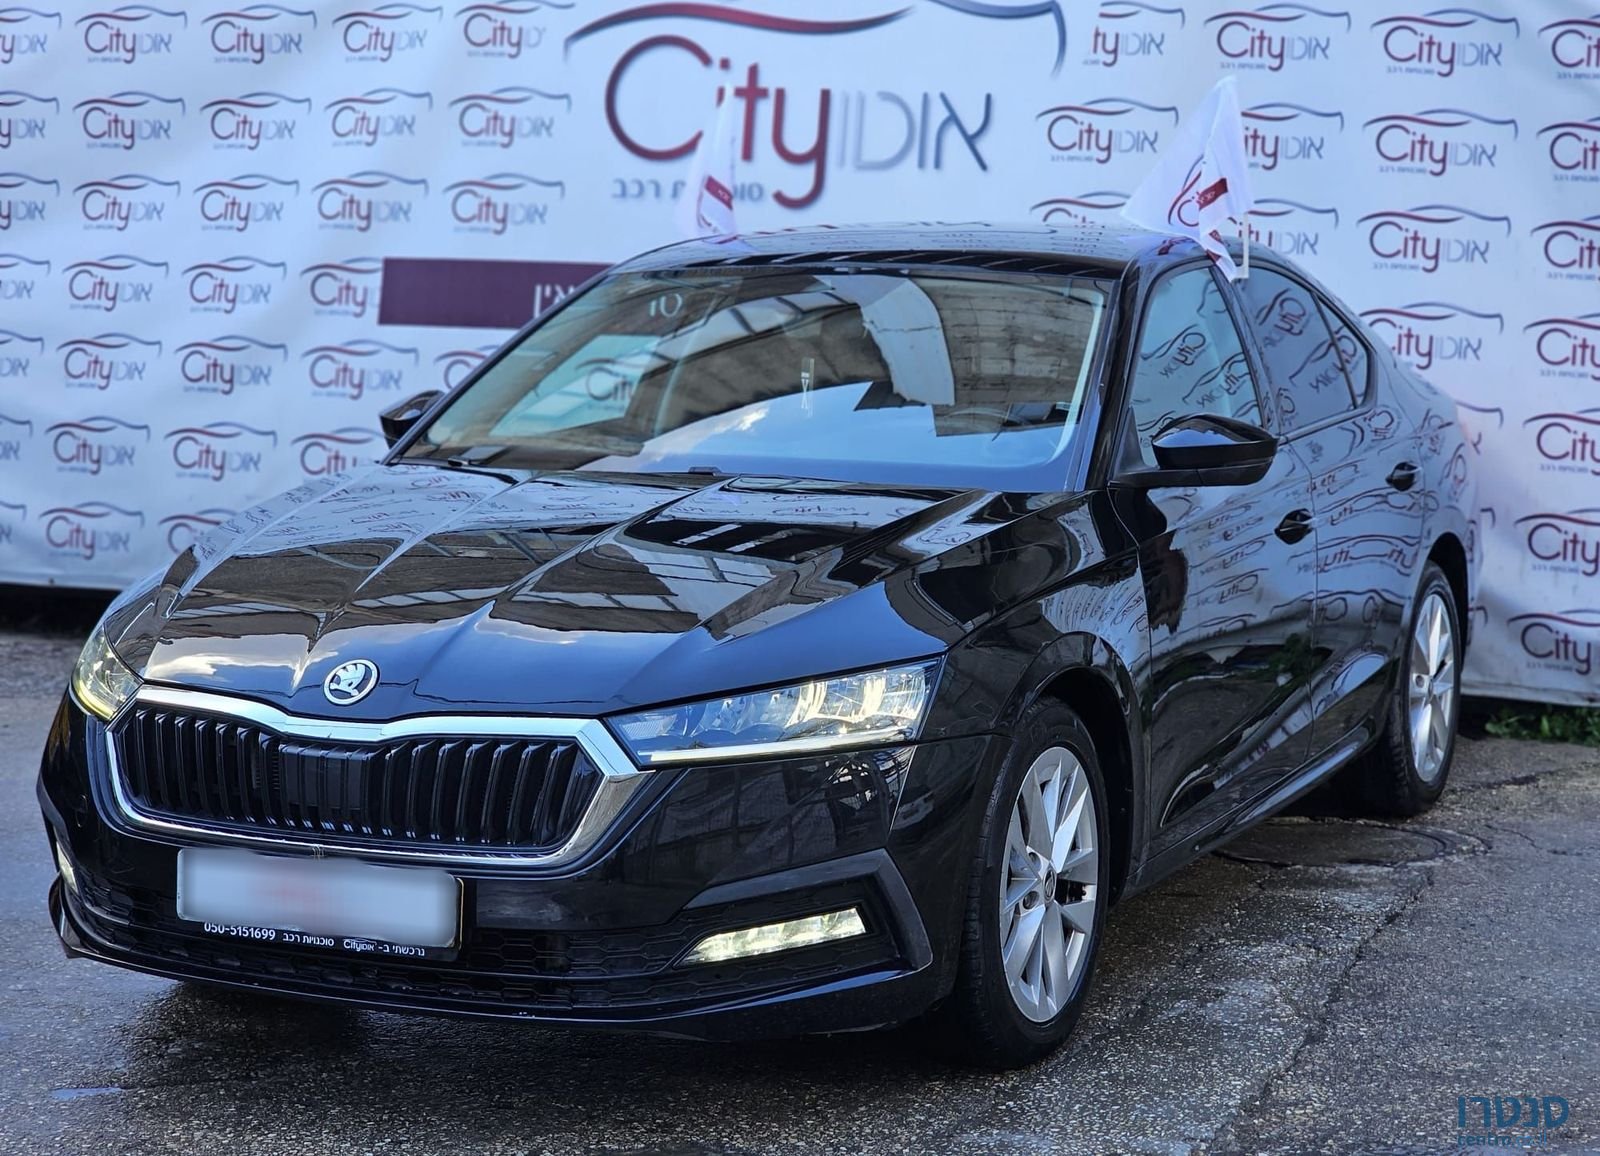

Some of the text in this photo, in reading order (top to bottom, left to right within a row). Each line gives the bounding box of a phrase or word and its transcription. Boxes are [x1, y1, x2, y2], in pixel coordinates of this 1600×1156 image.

[84, 20, 136, 64] City
[211, 20, 265, 64] City
[343, 20, 395, 62] City
[463, 12, 523, 59] City
[1216, 20, 1285, 72] City
[1383, 25, 1456, 78] City
[1551, 29, 1600, 68] Cit
[82, 106, 135, 150] City
[210, 107, 262, 151] City
[331, 105, 380, 147] City
[458, 102, 516, 149] City
[1047, 114, 1112, 164] City
[1244, 126, 1280, 171] ity
[1376, 124, 1448, 177] City
[1549, 132, 1600, 171] Cit
[82, 189, 132, 231] City
[201, 189, 251, 232] City
[317, 187, 372, 232] City
[451, 188, 509, 235] City
[1369, 220, 1441, 273] City
[1544, 230, 1600, 269] Cit
[69, 269, 119, 312] City
[189, 271, 239, 314] City
[310, 271, 368, 318] City
[64, 347, 113, 390] City
[181, 350, 235, 395] City
[309, 354, 365, 400] City
[53, 430, 101, 475] City
[173, 436, 226, 482] City
[46, 515, 96, 560] City
[1527, 522, 1600, 577] City
[1521, 622, 1592, 676] City
[204, 922, 276, 941] 050-5151699
[282, 932, 300, 943] רכב
[302, 934, 335, 947] סוכנויות
[392, 945, 425, 956] נרכשתי
